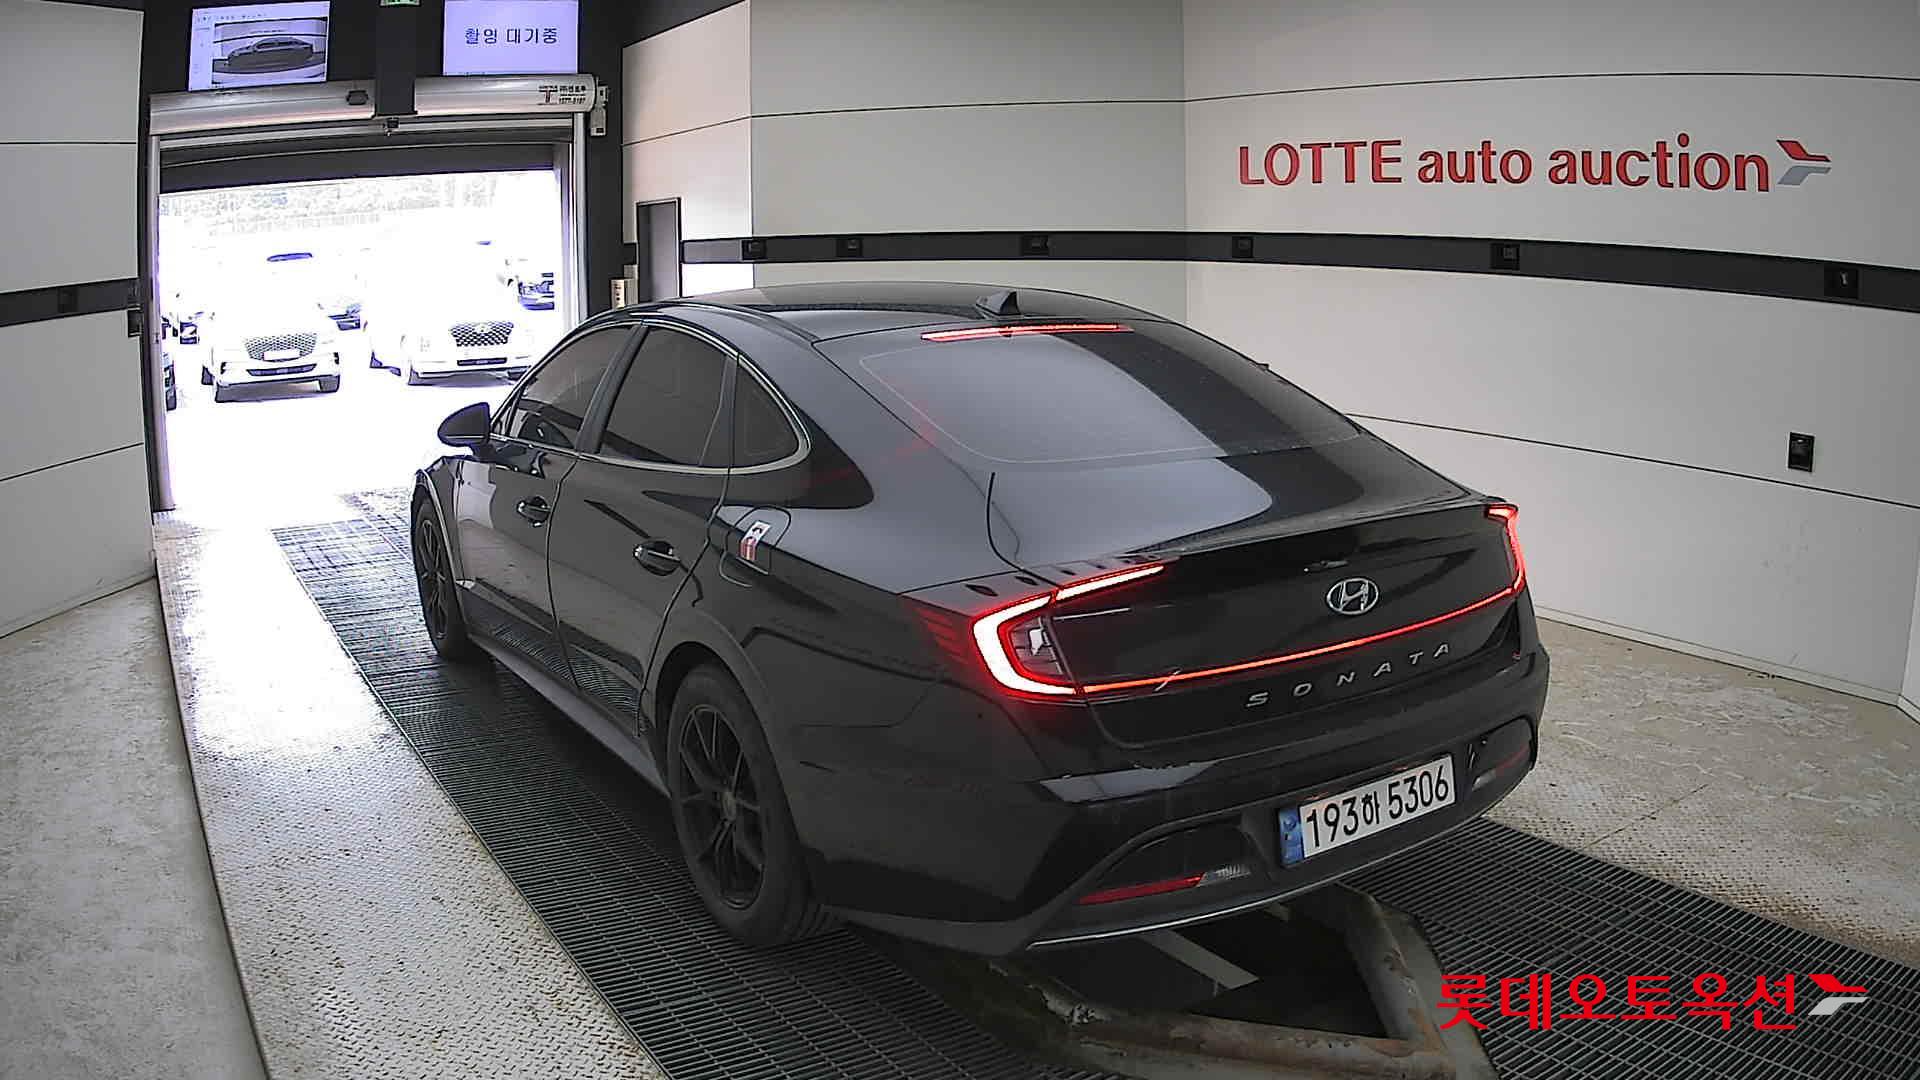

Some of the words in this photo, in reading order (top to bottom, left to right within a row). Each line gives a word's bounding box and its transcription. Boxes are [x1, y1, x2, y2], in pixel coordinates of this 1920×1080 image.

[506, 27, 558, 45] 대기중
[1238, 139, 1401, 186] LOTTE
[1417, 140, 1532, 184] auto
[1548, 132, 1770, 193] auction
[1246, 643, 1450, 708] SONATA
[1306, 790, 1381, 849] 193하
[1387, 764, 1449, 820] 5306
